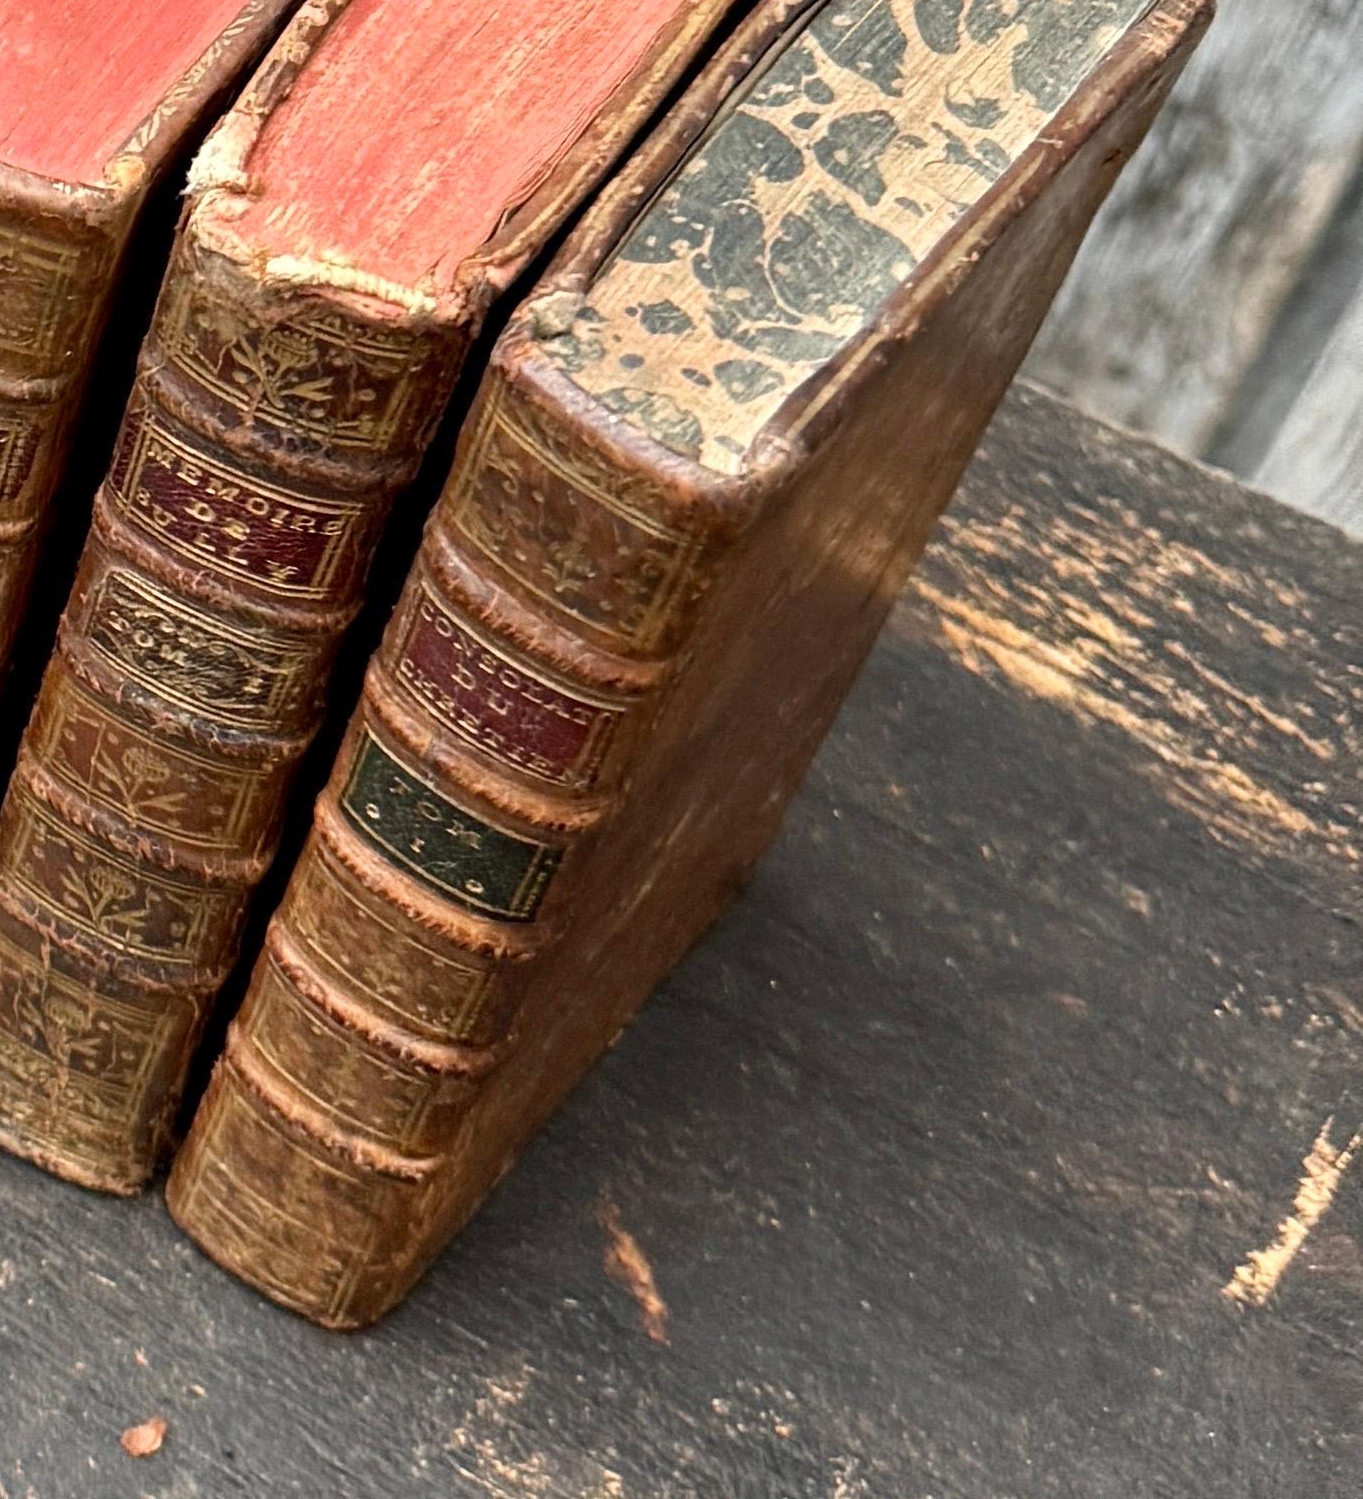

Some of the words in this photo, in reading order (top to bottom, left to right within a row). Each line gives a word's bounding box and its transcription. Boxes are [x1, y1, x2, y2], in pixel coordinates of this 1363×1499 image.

[136, 486, 300, 583] SULLY
[185, 499, 251, 542] DE
[451, 662, 514, 717] DU
[388, 775, 483, 851] TOM
